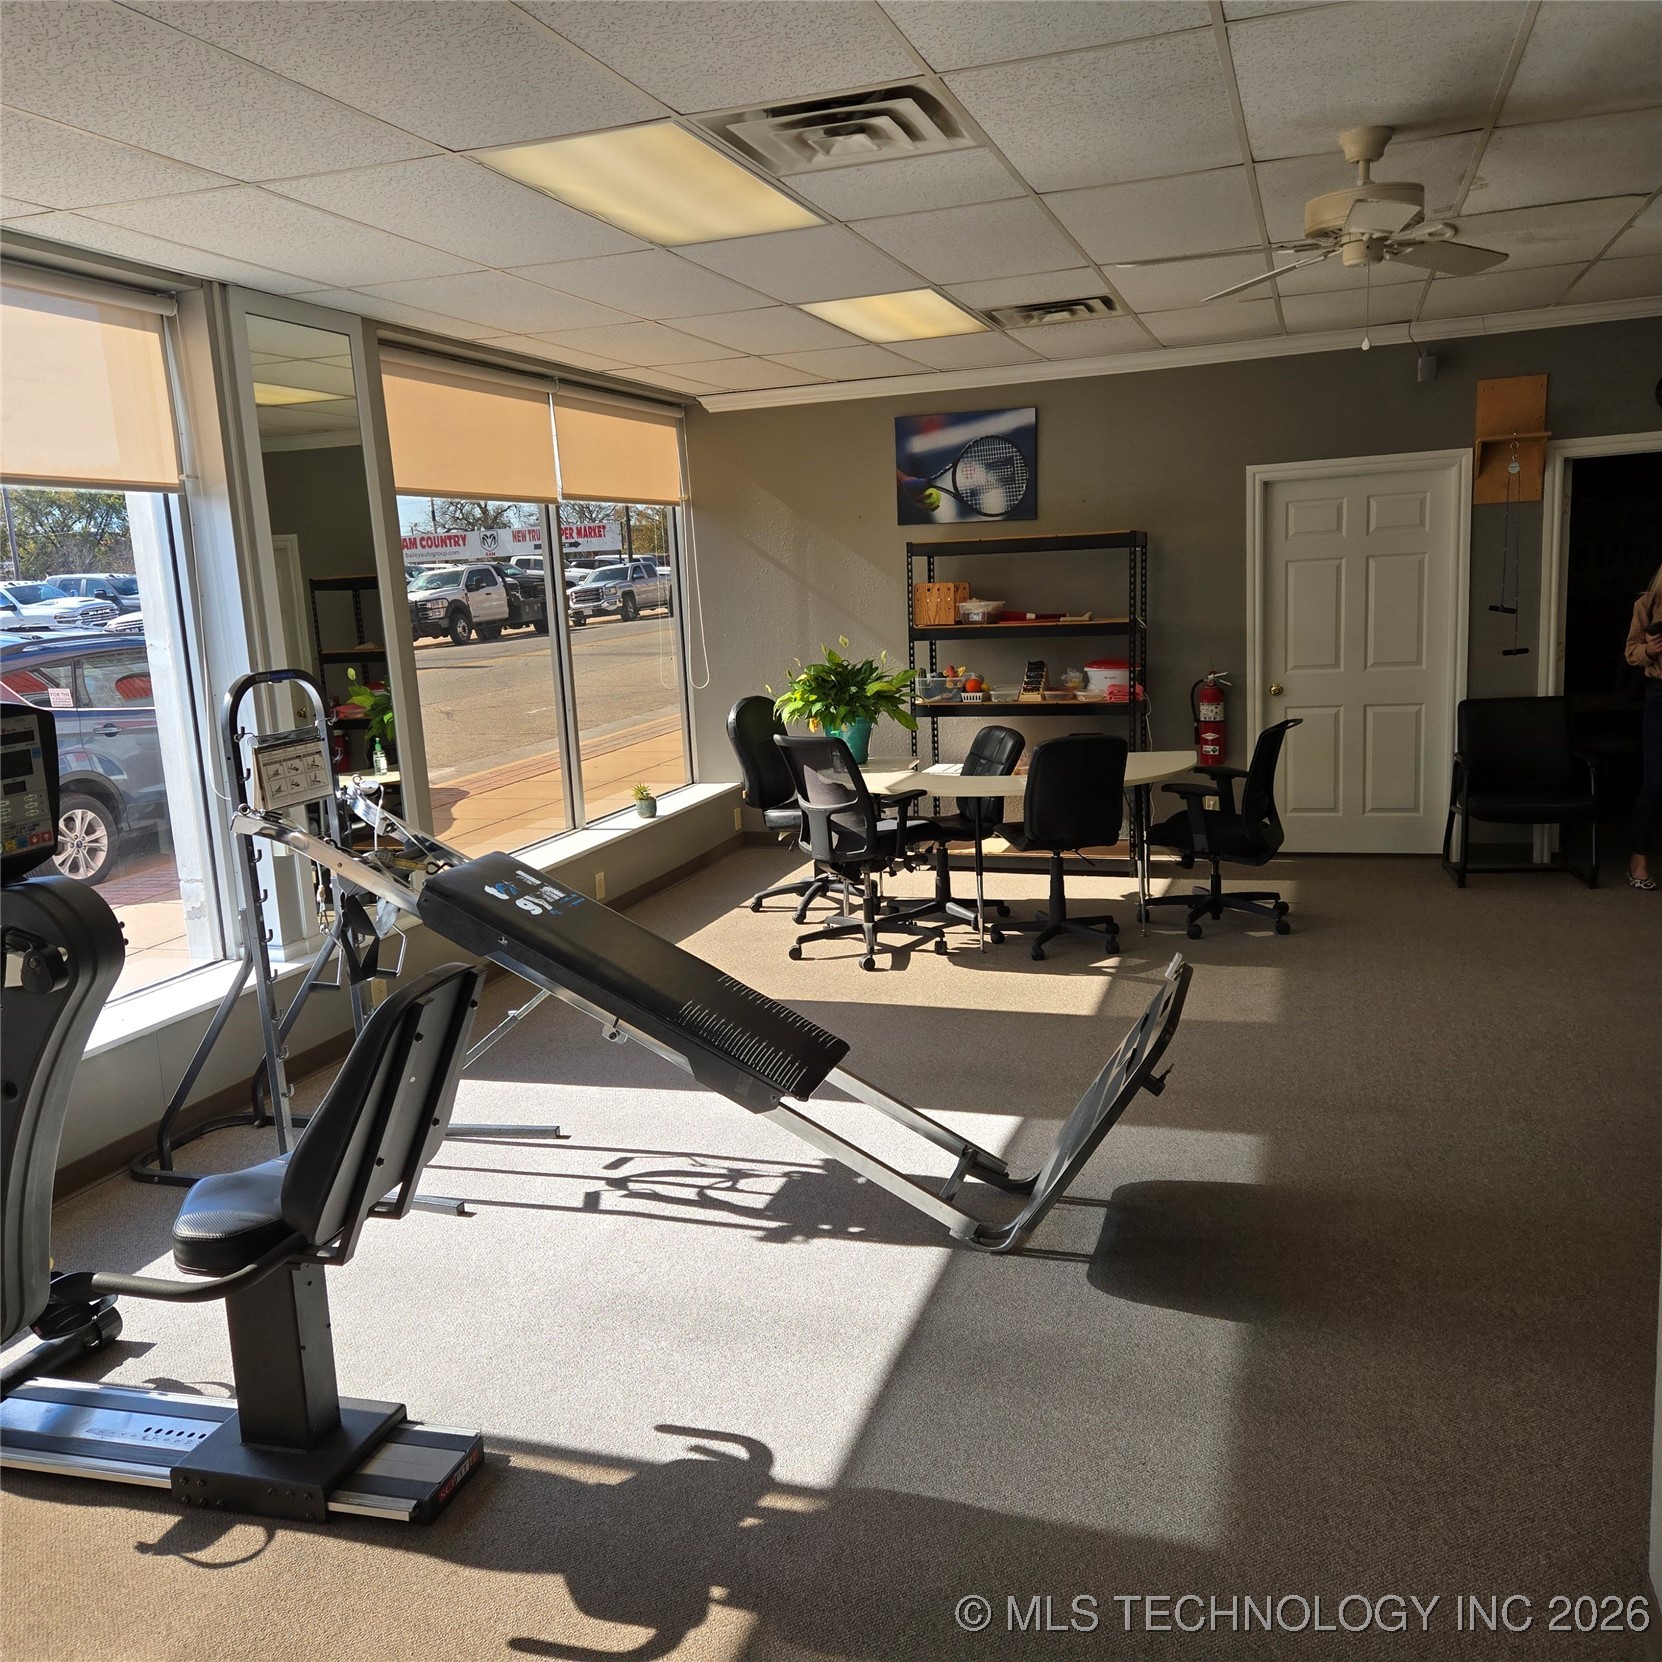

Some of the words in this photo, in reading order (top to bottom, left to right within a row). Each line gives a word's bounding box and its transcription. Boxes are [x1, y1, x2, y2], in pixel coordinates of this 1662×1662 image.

[401, 537, 418, 550] AM
[419, 533, 467, 549] COUNTRY
[512, 529, 526, 543] NEW
[527, 528, 541, 542] TRU
[560, 526, 574, 540] PER
[576, 524, 607, 539] MARKET
